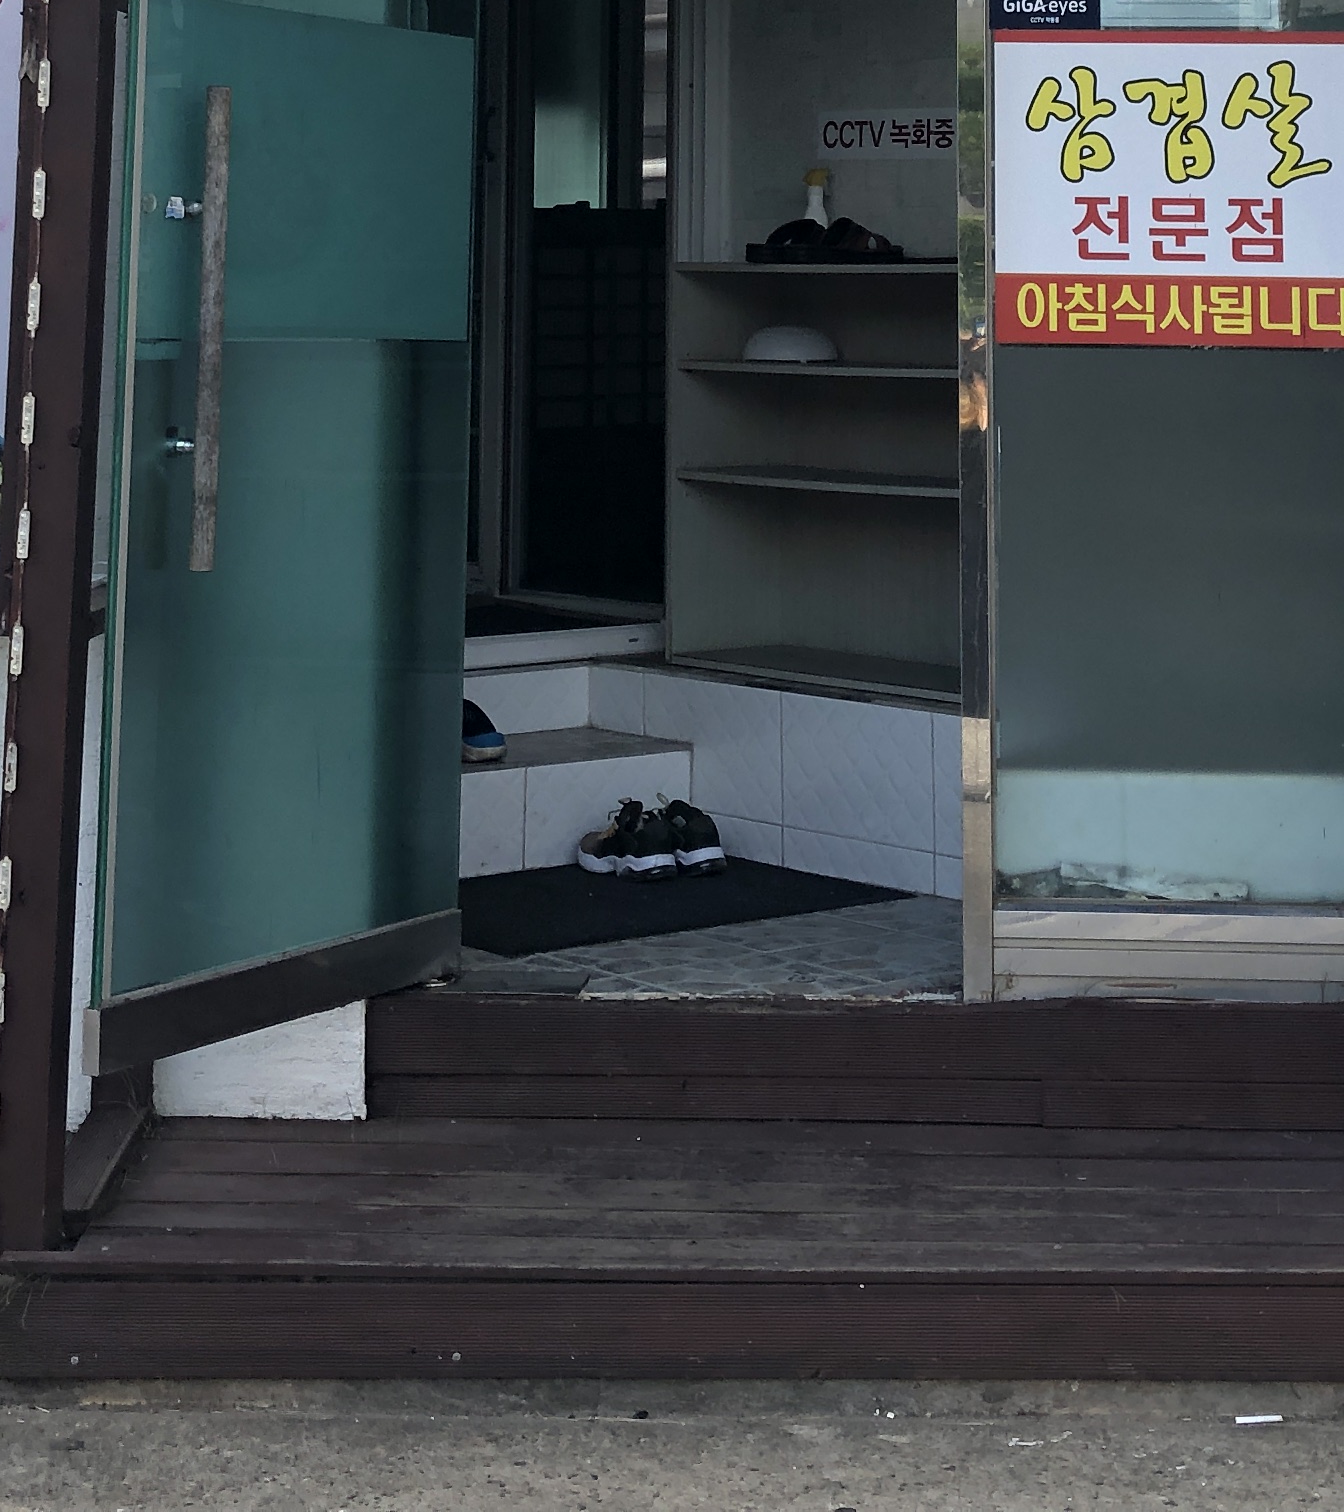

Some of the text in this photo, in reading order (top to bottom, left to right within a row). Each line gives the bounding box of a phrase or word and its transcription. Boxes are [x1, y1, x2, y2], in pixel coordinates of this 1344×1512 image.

[823, 118, 955, 148] CCTV 녹화중
[1025, 59, 1332, 189] 삼겹살
[1071, 195, 1286, 264] 전문점
